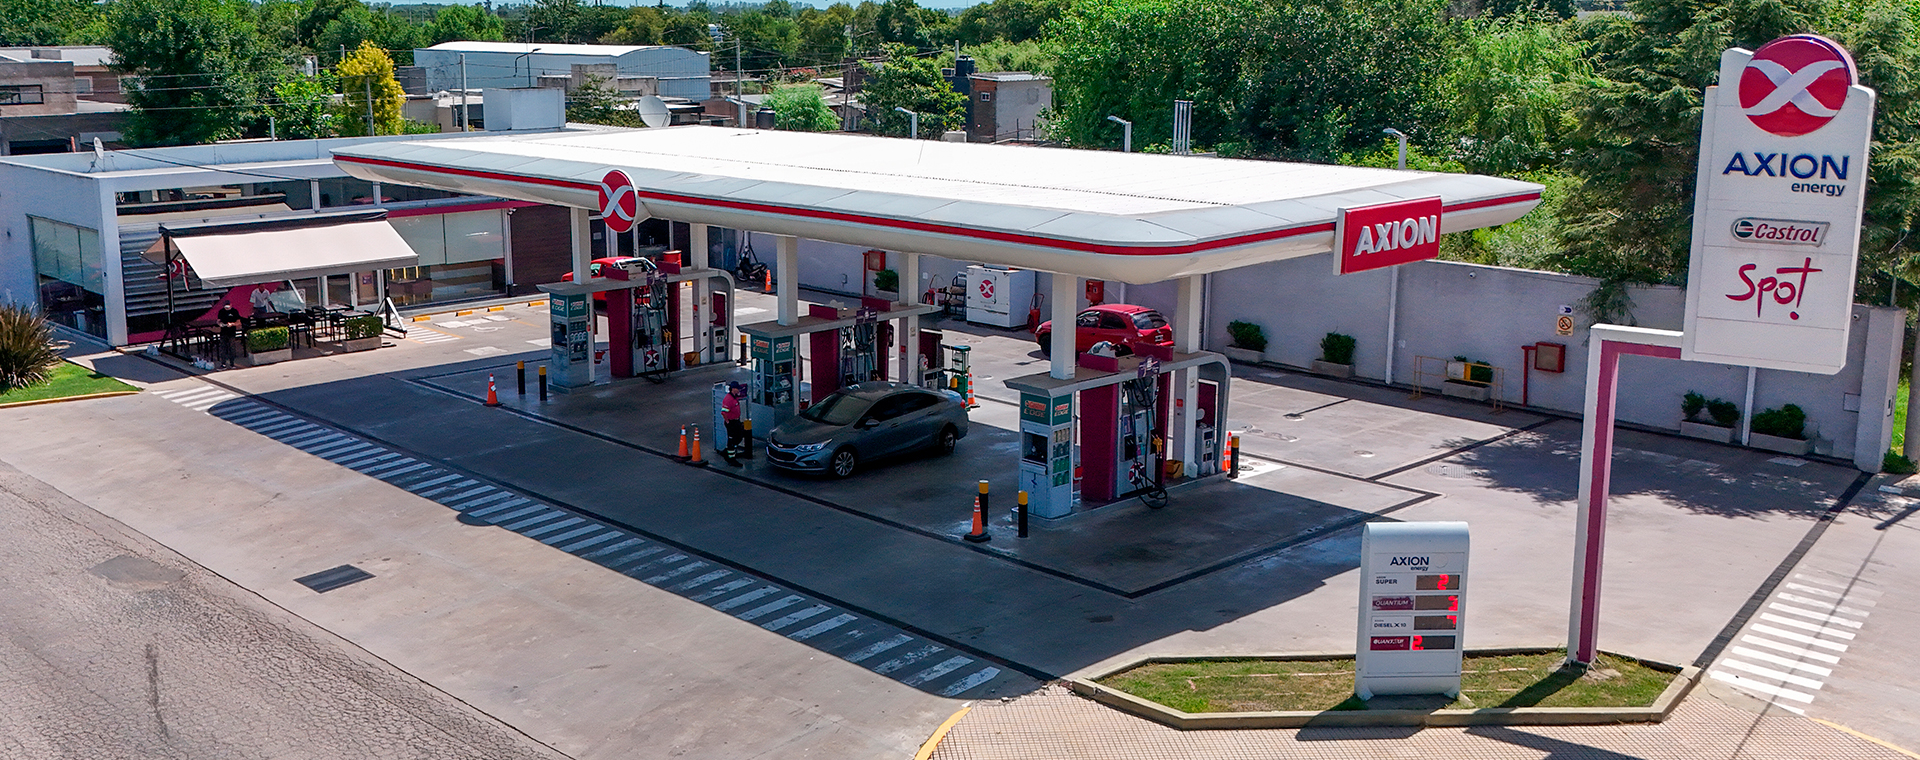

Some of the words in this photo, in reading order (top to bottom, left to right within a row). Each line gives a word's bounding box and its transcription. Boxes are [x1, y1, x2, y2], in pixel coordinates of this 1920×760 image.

[1722, 152, 1849, 180] AXION
[1791, 182, 1845, 197] energy
[1353, 215, 1437, 257] AXION
[1755, 223, 1819, 242] Castrol
[1390, 556, 1429, 566] AXION
